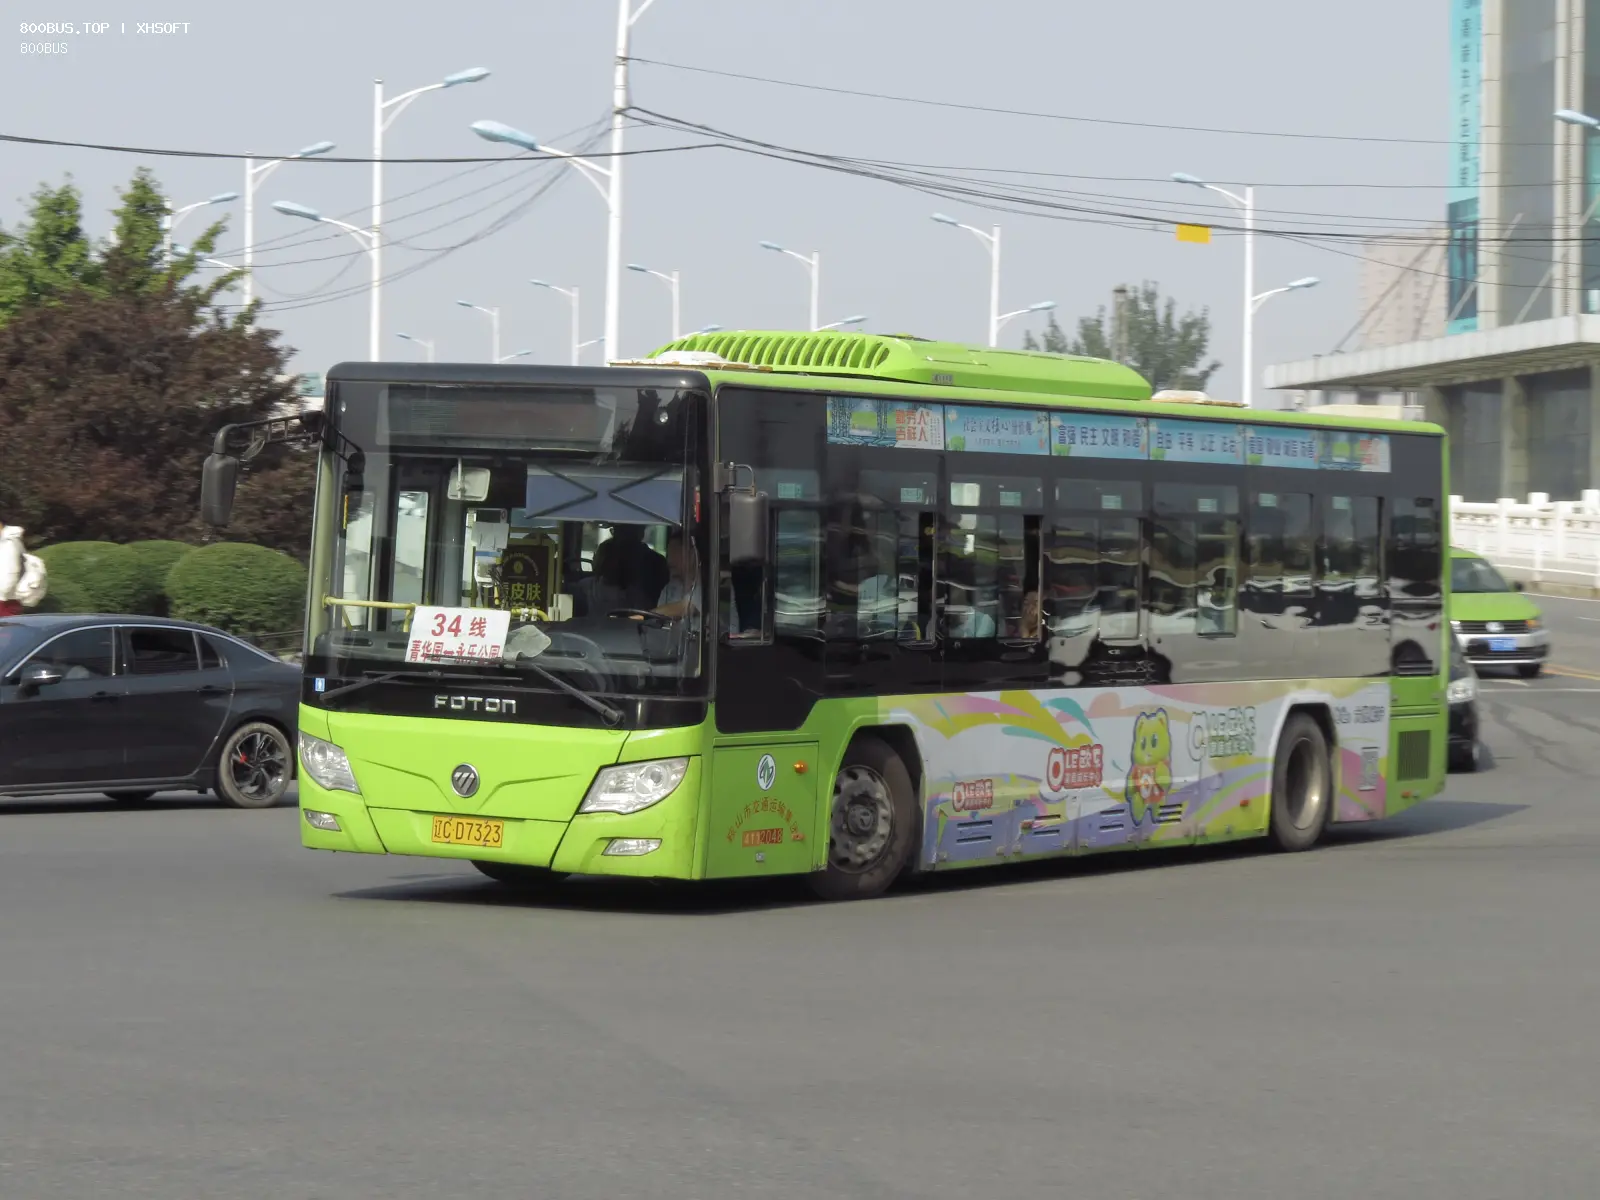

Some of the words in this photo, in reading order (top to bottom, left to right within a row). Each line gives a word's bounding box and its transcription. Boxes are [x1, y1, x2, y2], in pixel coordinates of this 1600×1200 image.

[431, 613, 462, 638] 34
[468, 617, 487, 639] 线
[434, 695, 517, 714] FOTON
